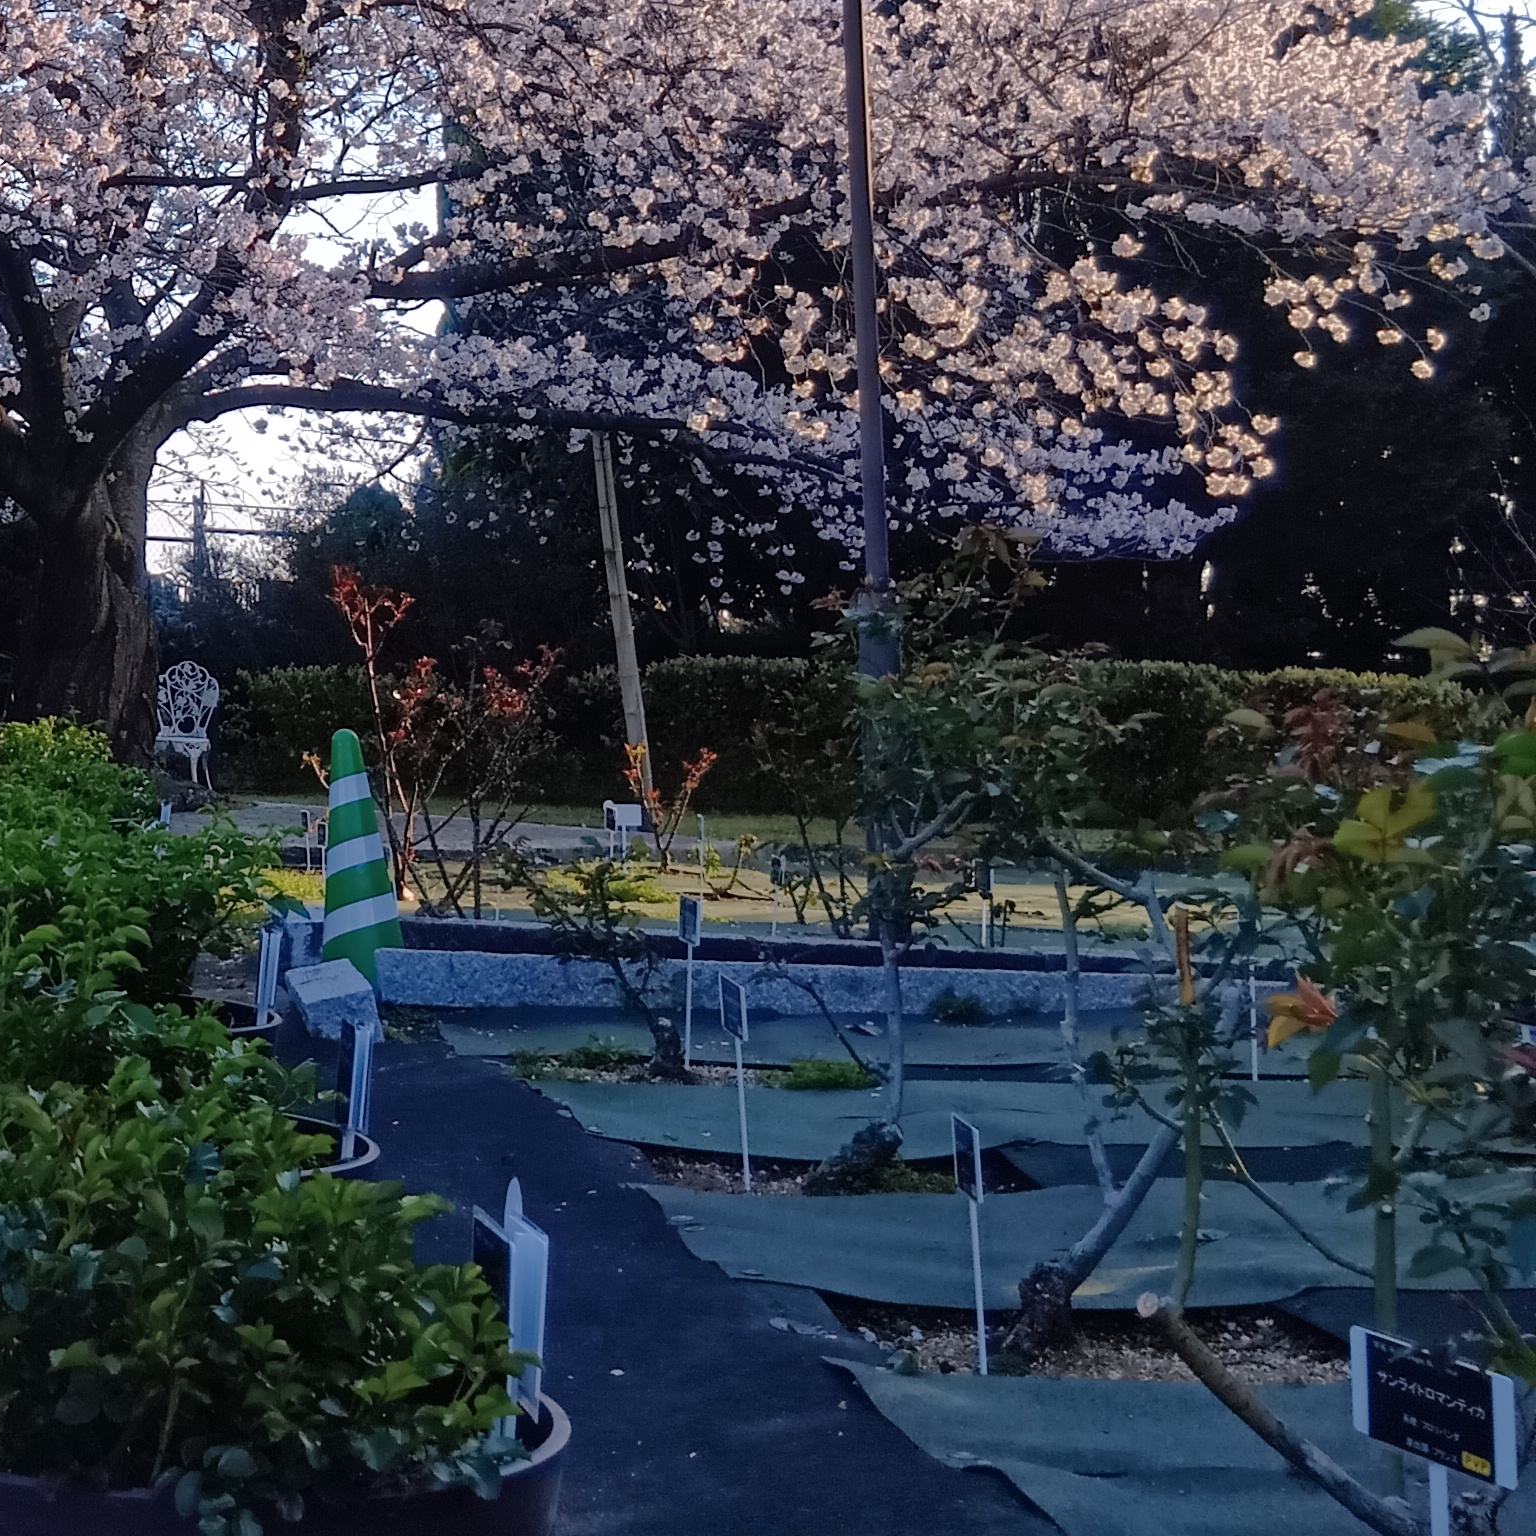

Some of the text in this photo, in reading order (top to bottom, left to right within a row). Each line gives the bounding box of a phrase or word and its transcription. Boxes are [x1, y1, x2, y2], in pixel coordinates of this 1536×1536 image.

[1377, 1371, 1486, 1420] サンライトロマンティカ
